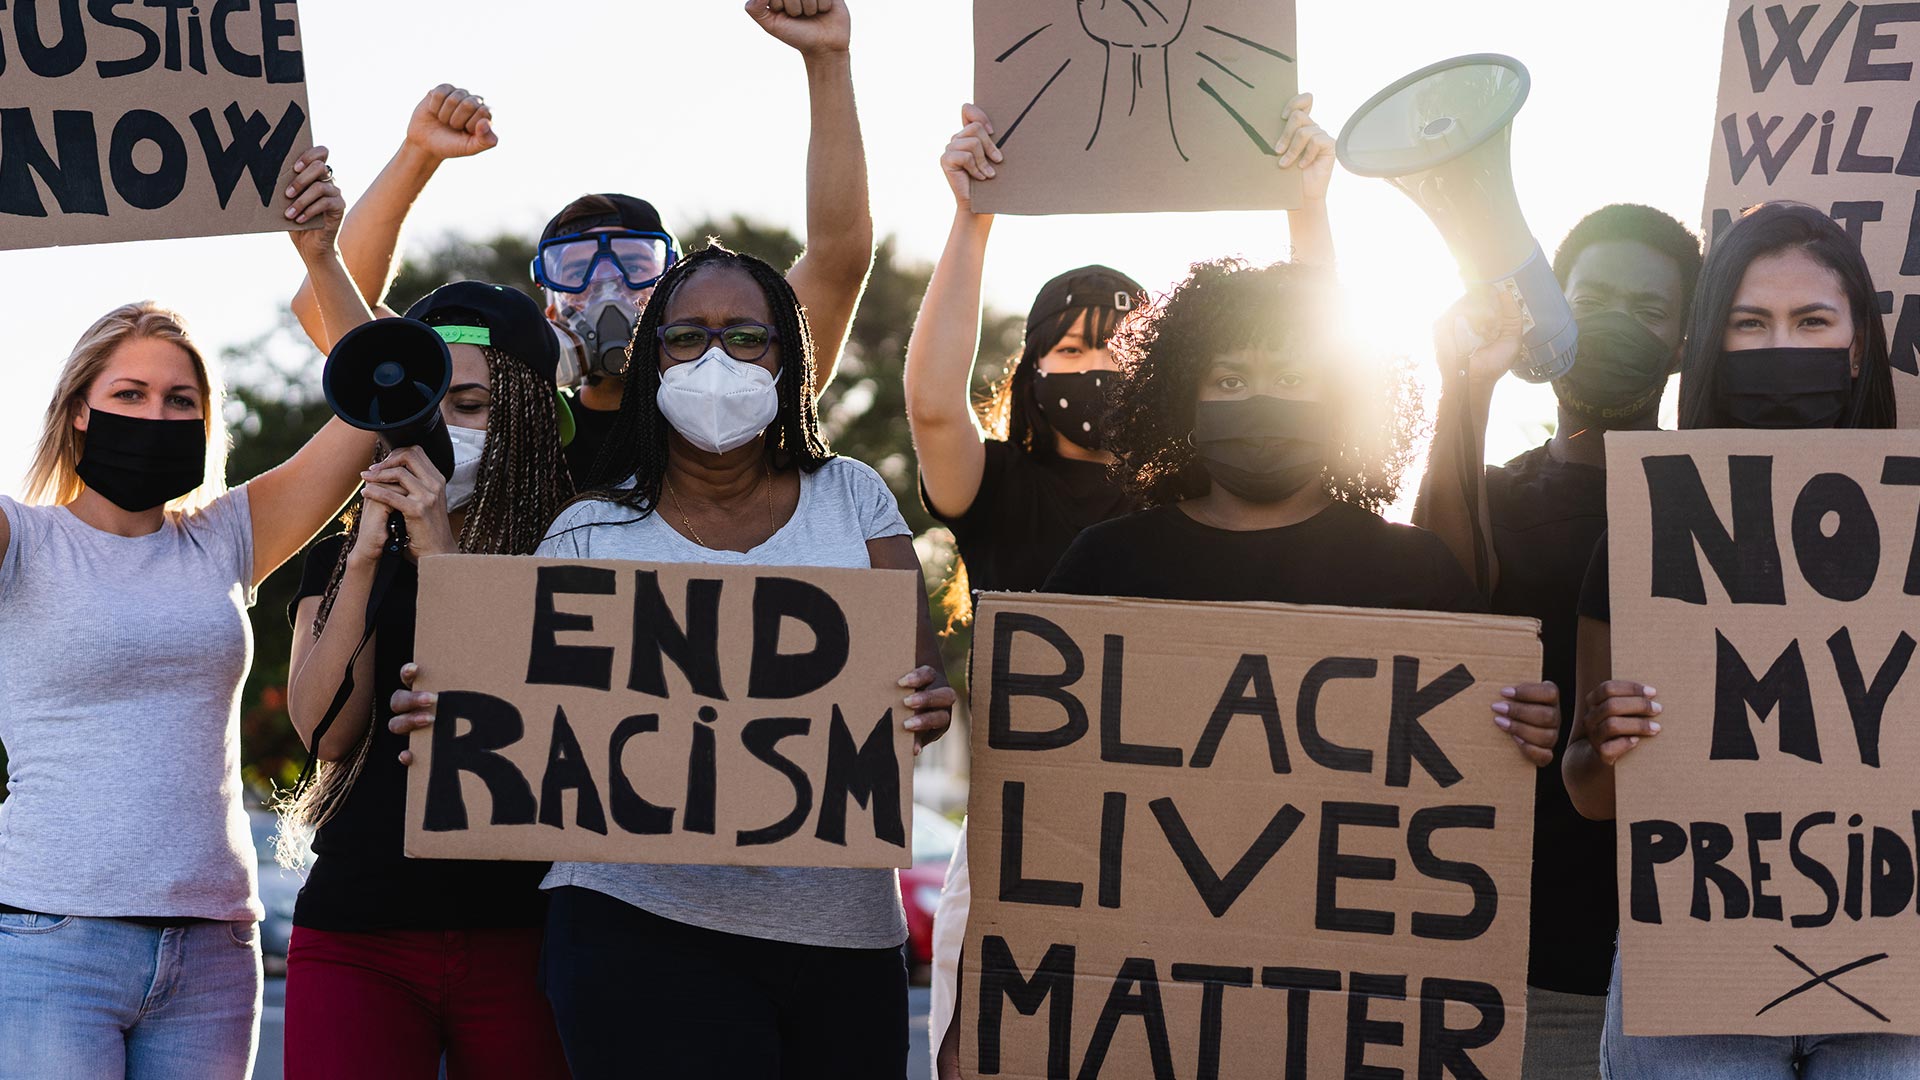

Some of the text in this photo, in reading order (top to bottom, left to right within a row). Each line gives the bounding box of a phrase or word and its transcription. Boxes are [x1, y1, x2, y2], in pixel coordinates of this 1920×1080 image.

[1738, 0, 1920, 93] WE
[0, 101, 305, 217] NOW
[525, 565, 849, 701] END
[988, 612, 1475, 788] BLACK
[1710, 625, 1917, 768] MY
[423, 690, 905, 848] RACiSM
[999, 781, 1498, 940] LIVES
[1630, 811, 1920, 928] PRESiD
[977, 935, 1505, 1080] MATTER
